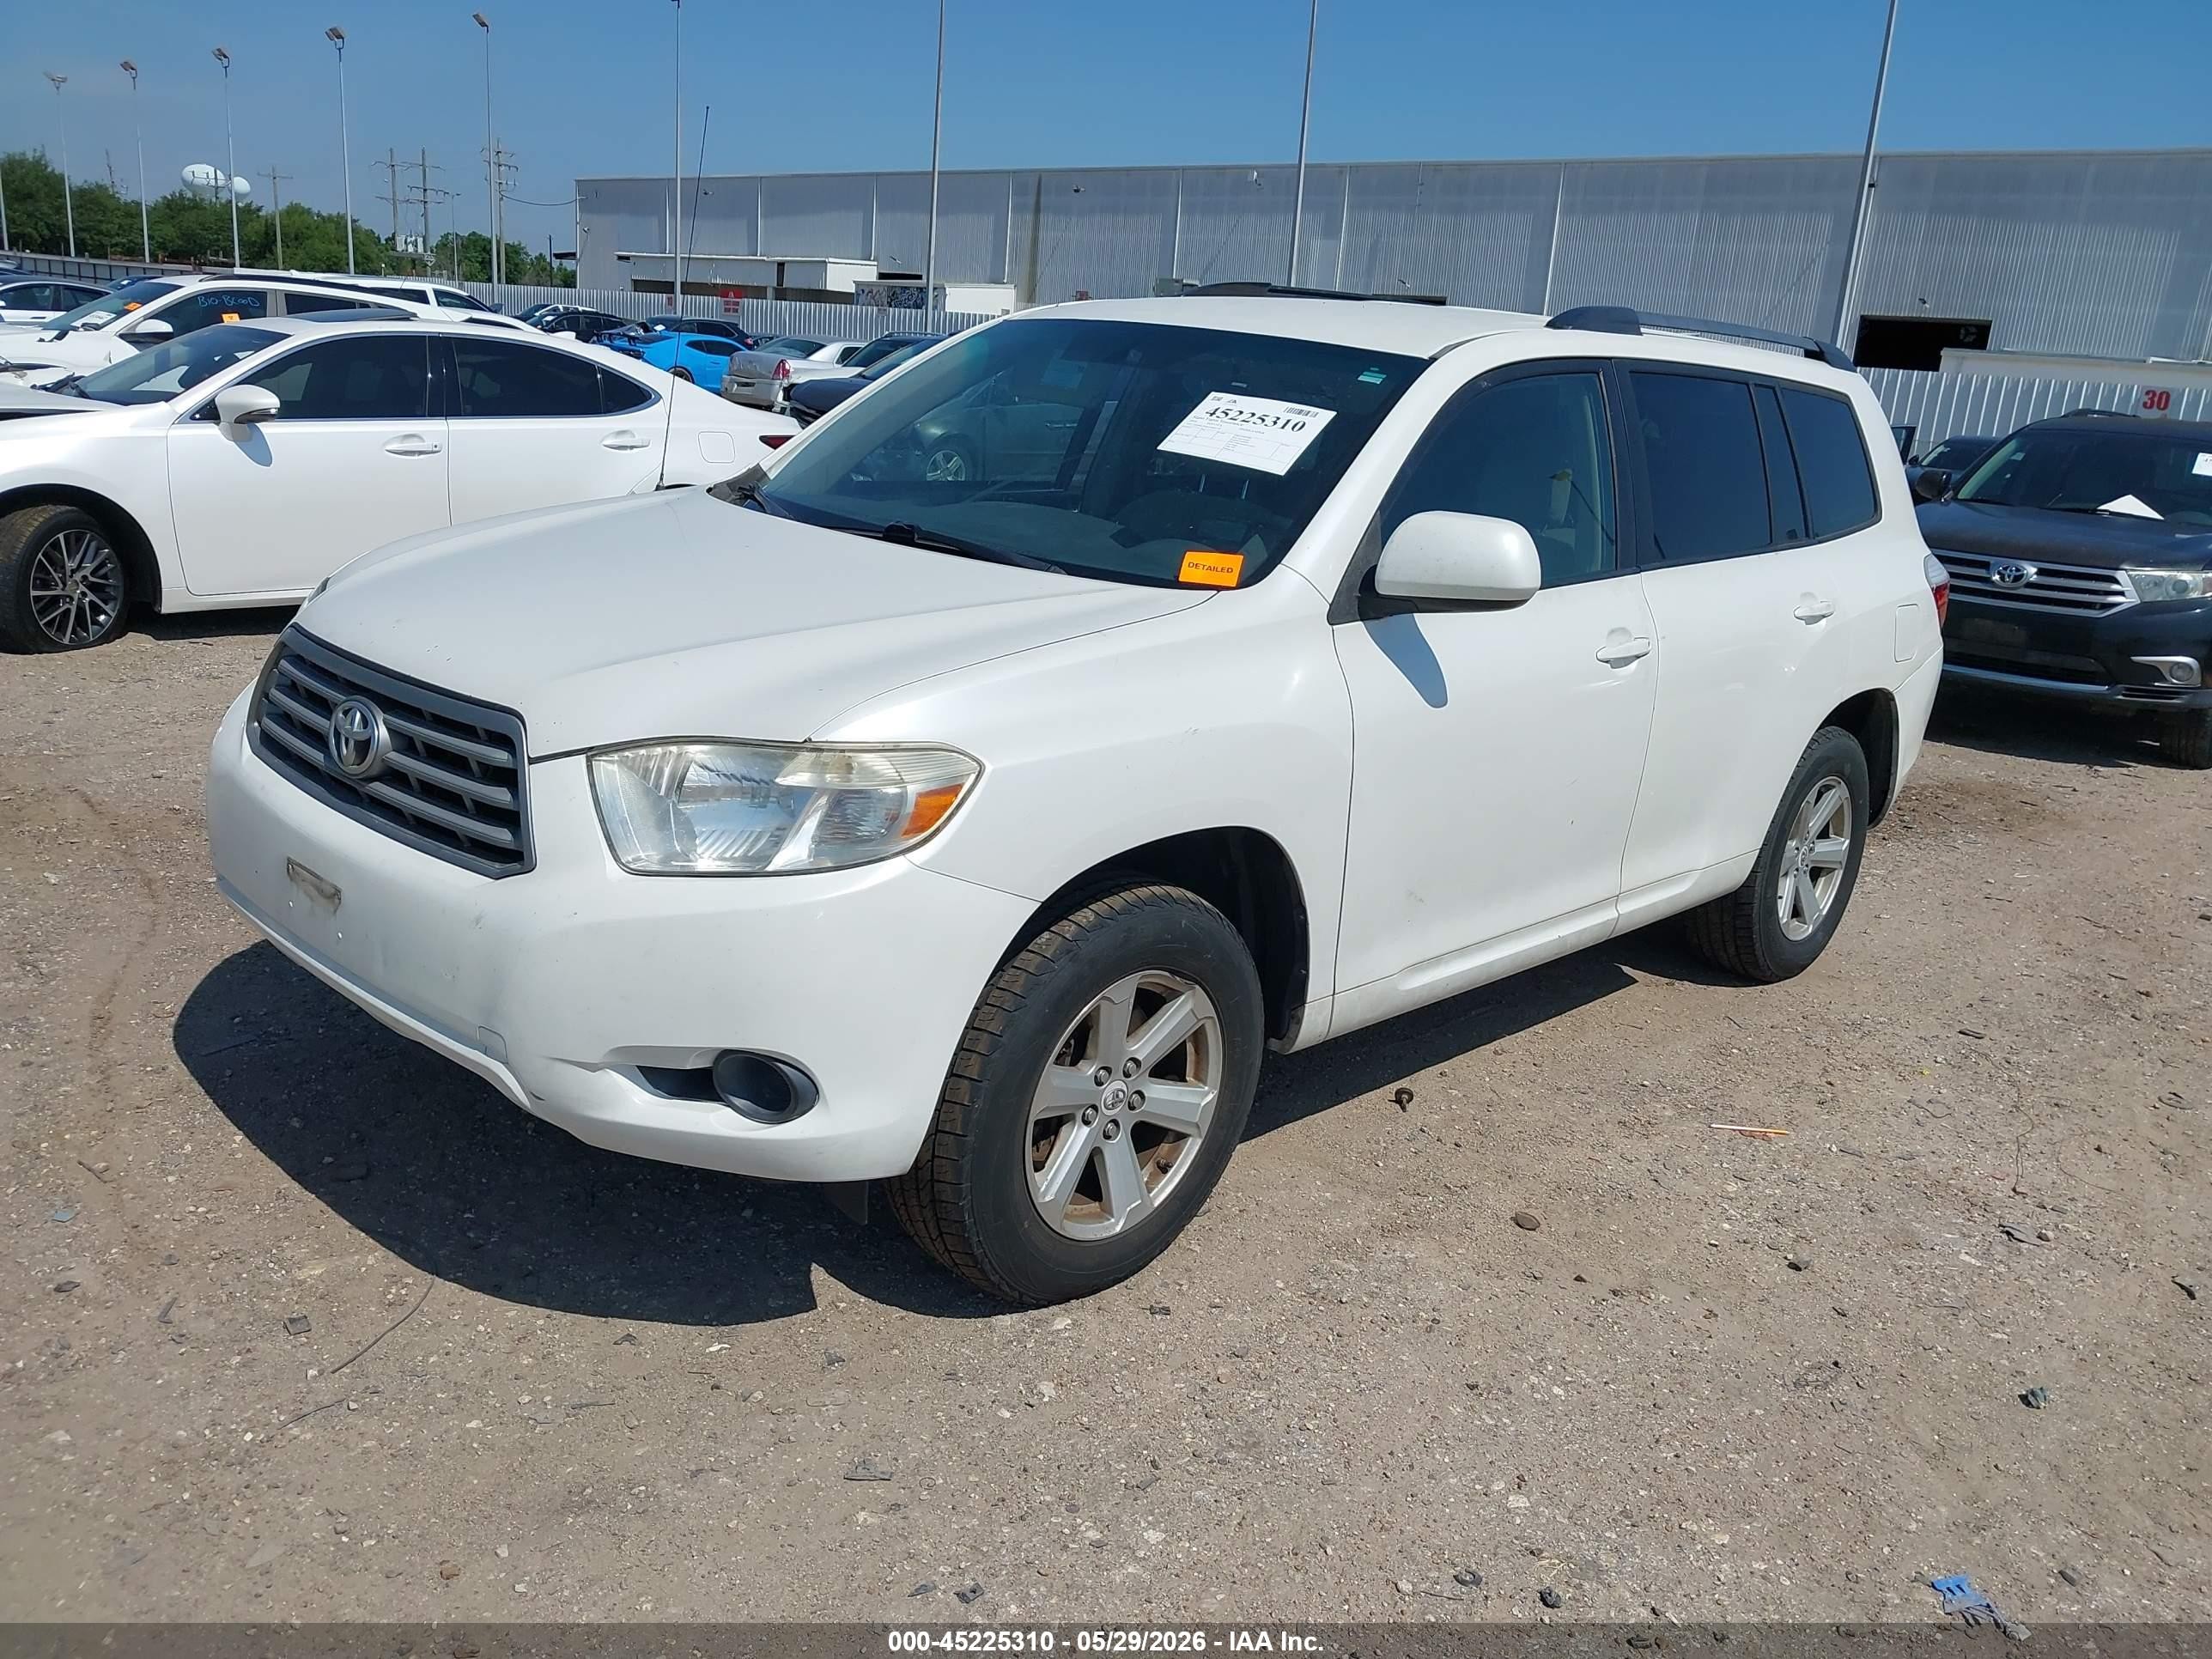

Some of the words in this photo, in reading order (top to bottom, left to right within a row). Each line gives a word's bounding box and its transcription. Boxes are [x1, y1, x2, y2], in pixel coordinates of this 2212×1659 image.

[2142, 389, 2171, 411] 30
[1206, 406, 1306, 433] 45225310
[1188, 562, 1234, 574] DETAILED
